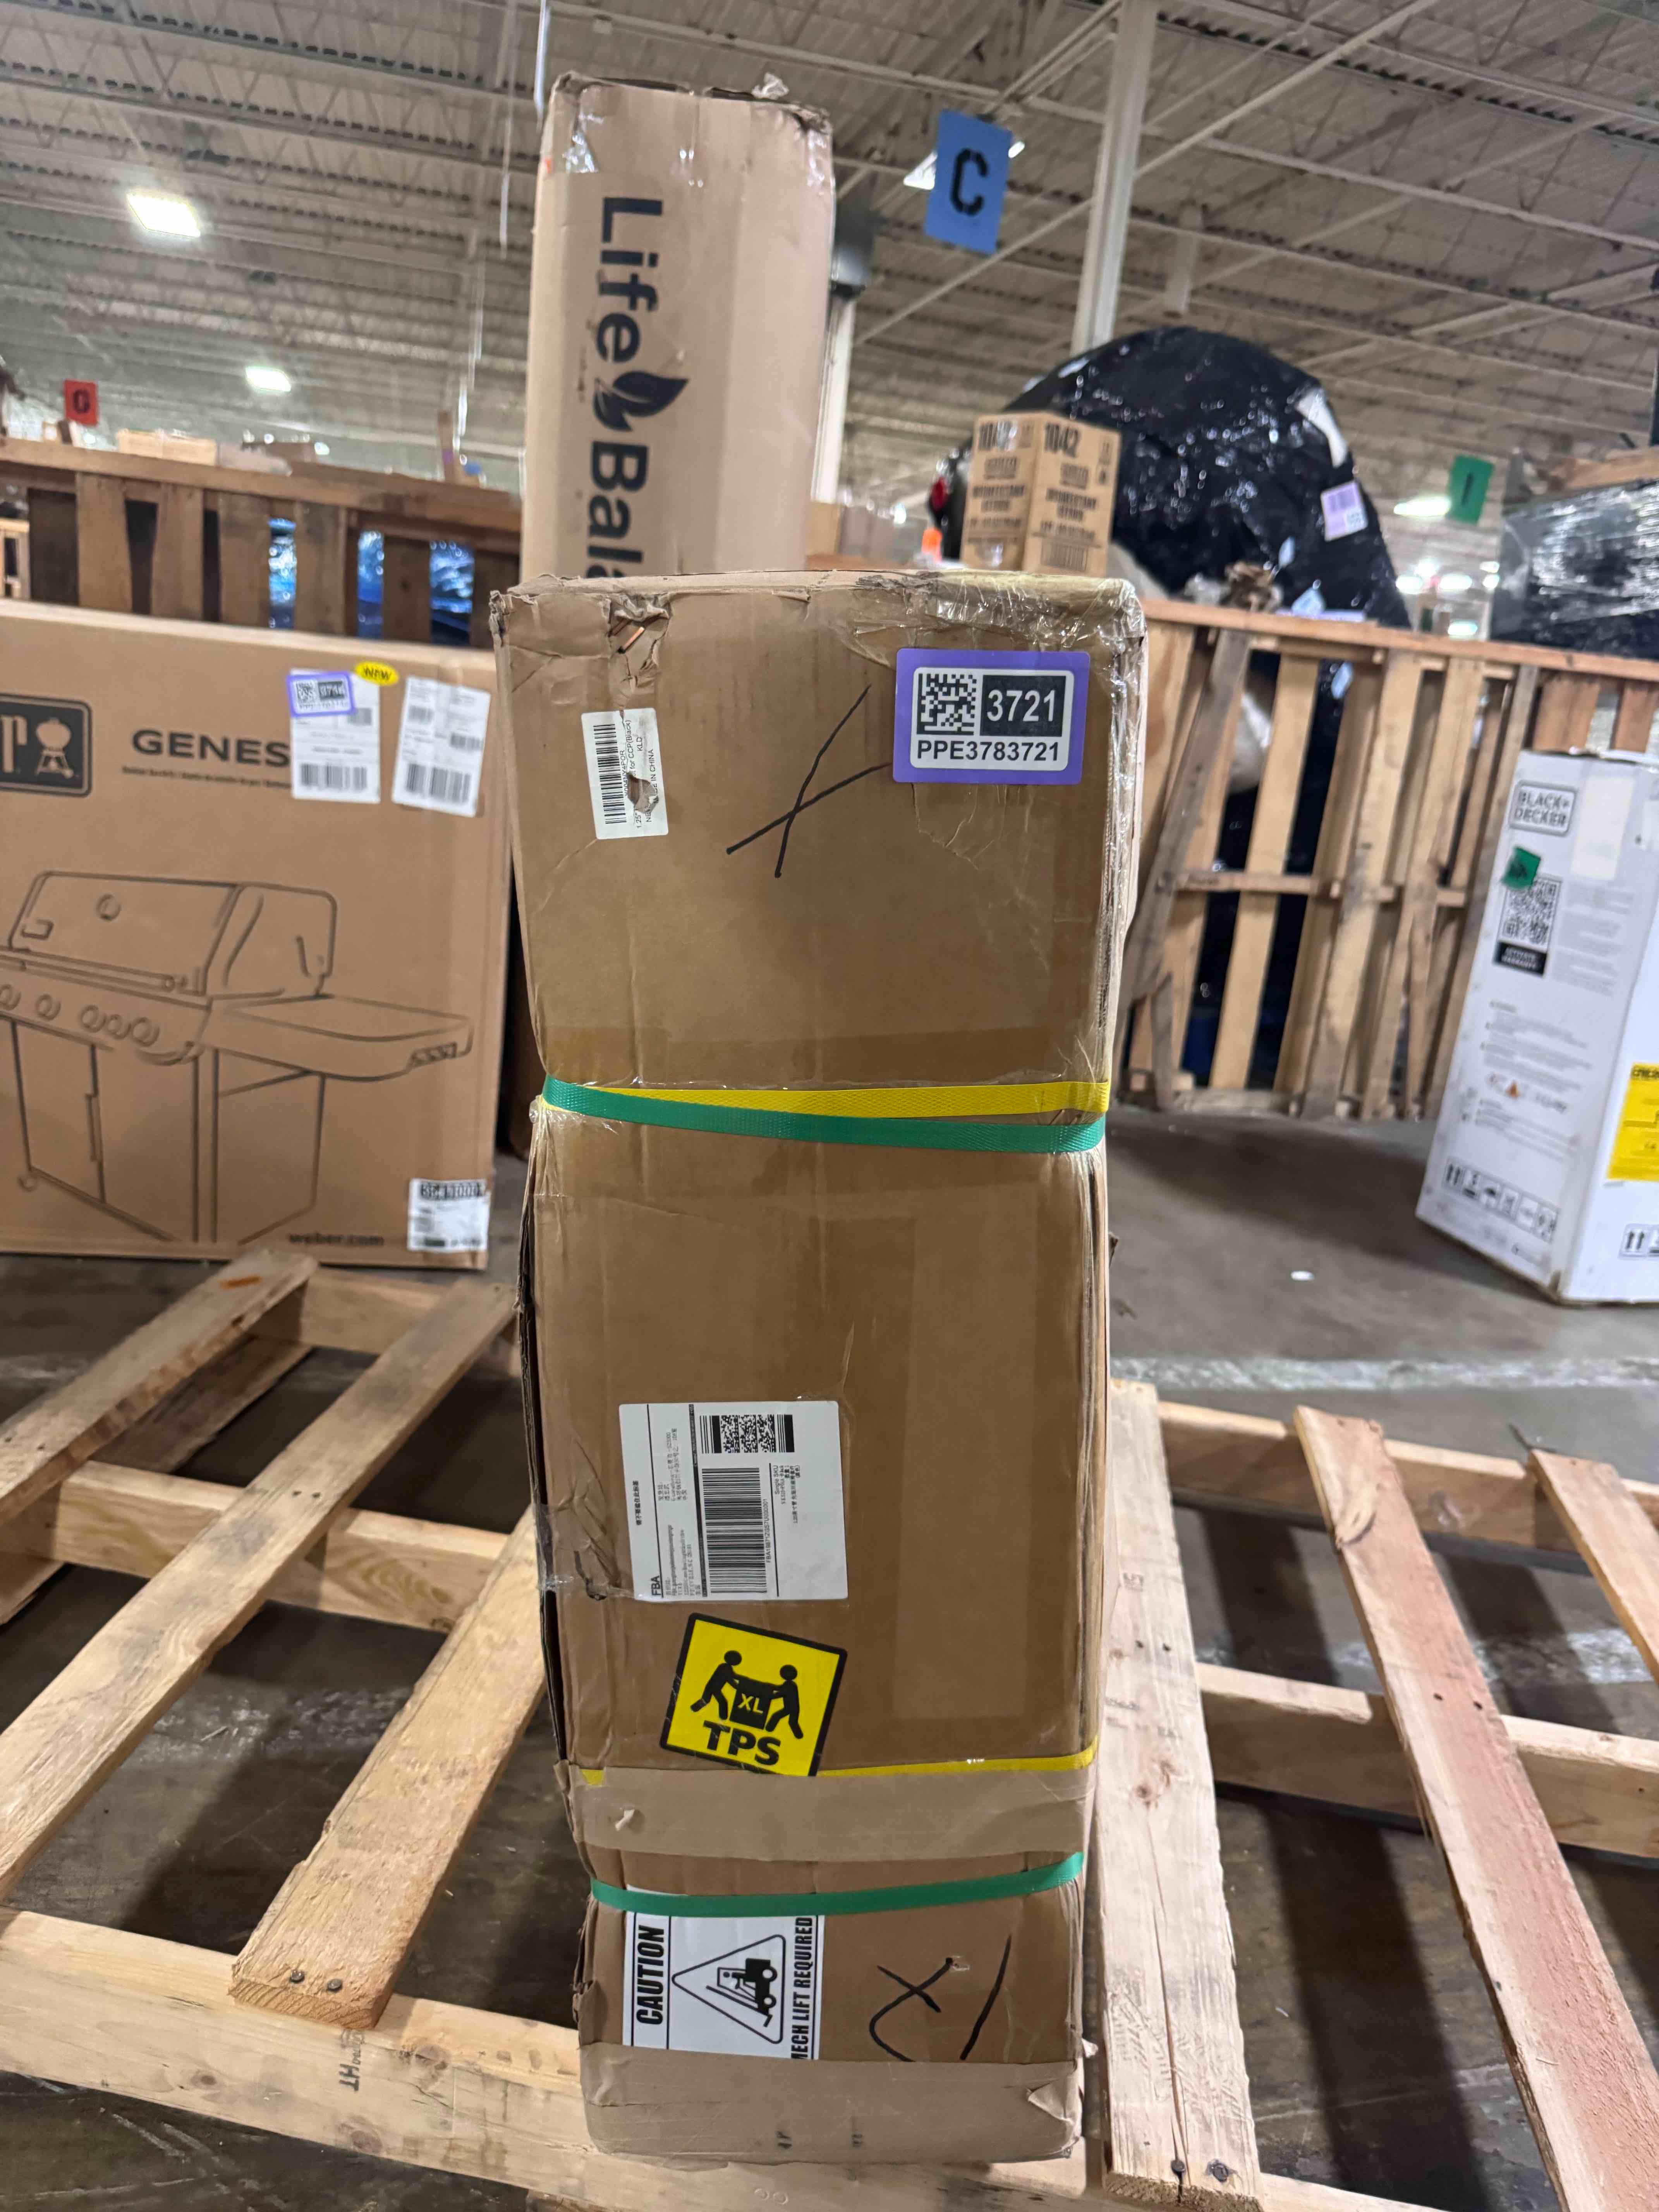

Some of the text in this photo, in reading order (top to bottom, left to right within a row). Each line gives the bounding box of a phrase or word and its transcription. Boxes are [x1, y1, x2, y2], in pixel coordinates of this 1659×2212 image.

[950, 147, 989, 217] C
[586, 198, 663, 578] Life Bal
[987, 690, 1055, 721] 3721
[625, 720, 634, 758] CCP(Black)
[917, 740, 1058, 761] PPE3783721
[1515, 808, 1566, 826] DECKER
[651, 1575, 661, 1595] FBA
[738, 1693, 763, 1714] XL
[703, 1720, 781, 1765] TPS
[793, 1917, 812, 1988] REQUIRED
[636, 1925, 664, 2025] CAUTION
[792, 1992, 811, 2021] LIFT
[338, 2063, 360, 2092] HT
